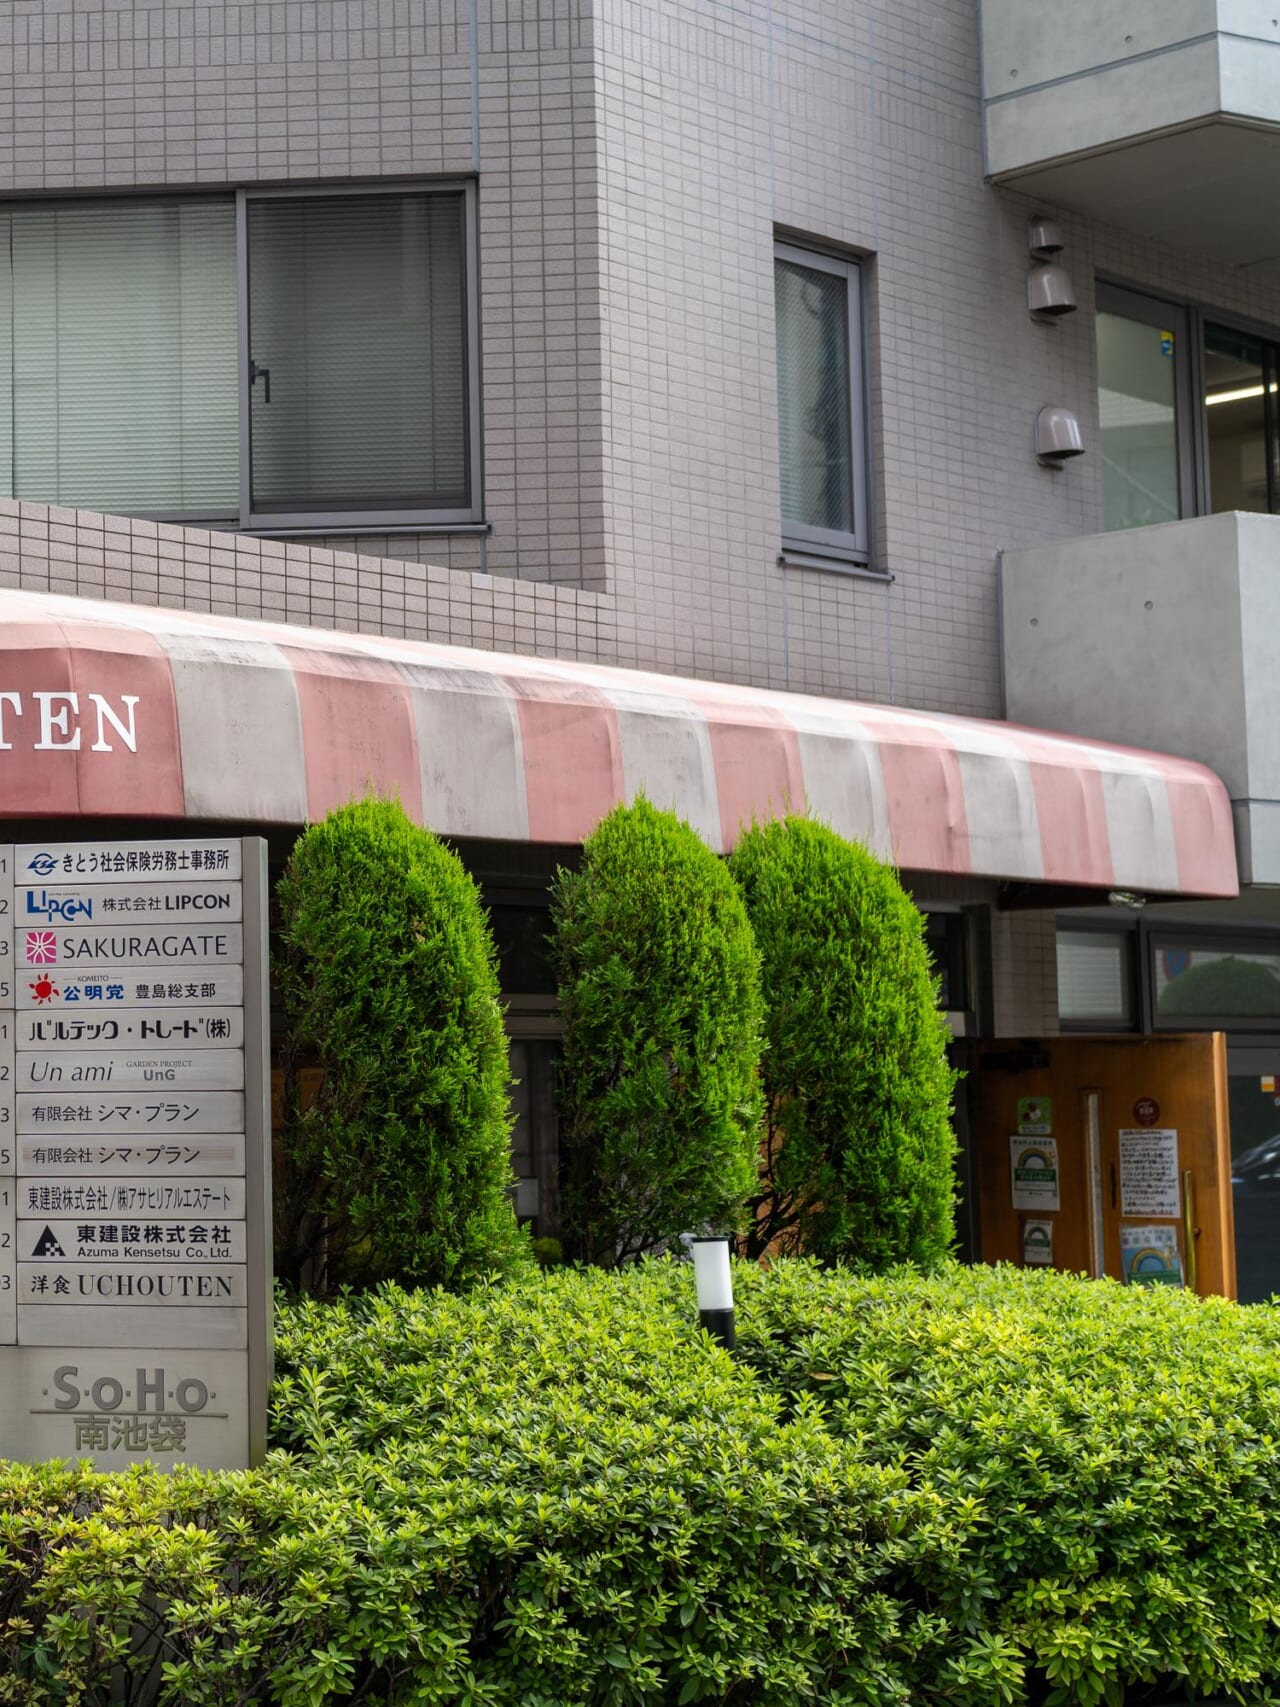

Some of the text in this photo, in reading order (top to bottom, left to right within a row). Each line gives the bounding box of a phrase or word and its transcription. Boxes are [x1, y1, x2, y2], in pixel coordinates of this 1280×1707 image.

[63, 850, 229, 872] きとう社会保険労務士事務所
[103, 897, 161, 911] 株式会社
[166, 894, 230, 910] LIPCON
[64, 936, 227, 958] SAKURAGATE
[64, 983, 215, 1001] 公明党 豊島総支部
[31, 1061, 113, 1081] Un ami
[126, 1060, 193, 1069] GARDEN PROJECT
[144, 1069, 175, 1081] UnG
[32, 1103, 200, 1123] 有限会社 シマ・プラン
[32, 1145, 200, 1164] 有限会社 シマ・プラン
[77, 1225, 231, 1244] 東建設株式会社
[78, 1247, 118, 1256] Azuma
[125, 1247, 180, 1257] Kensetsu
[32, 1275, 232, 1296] 洋食 UCHOUTEN
[73, 1415, 187, 1452] 南池袋
